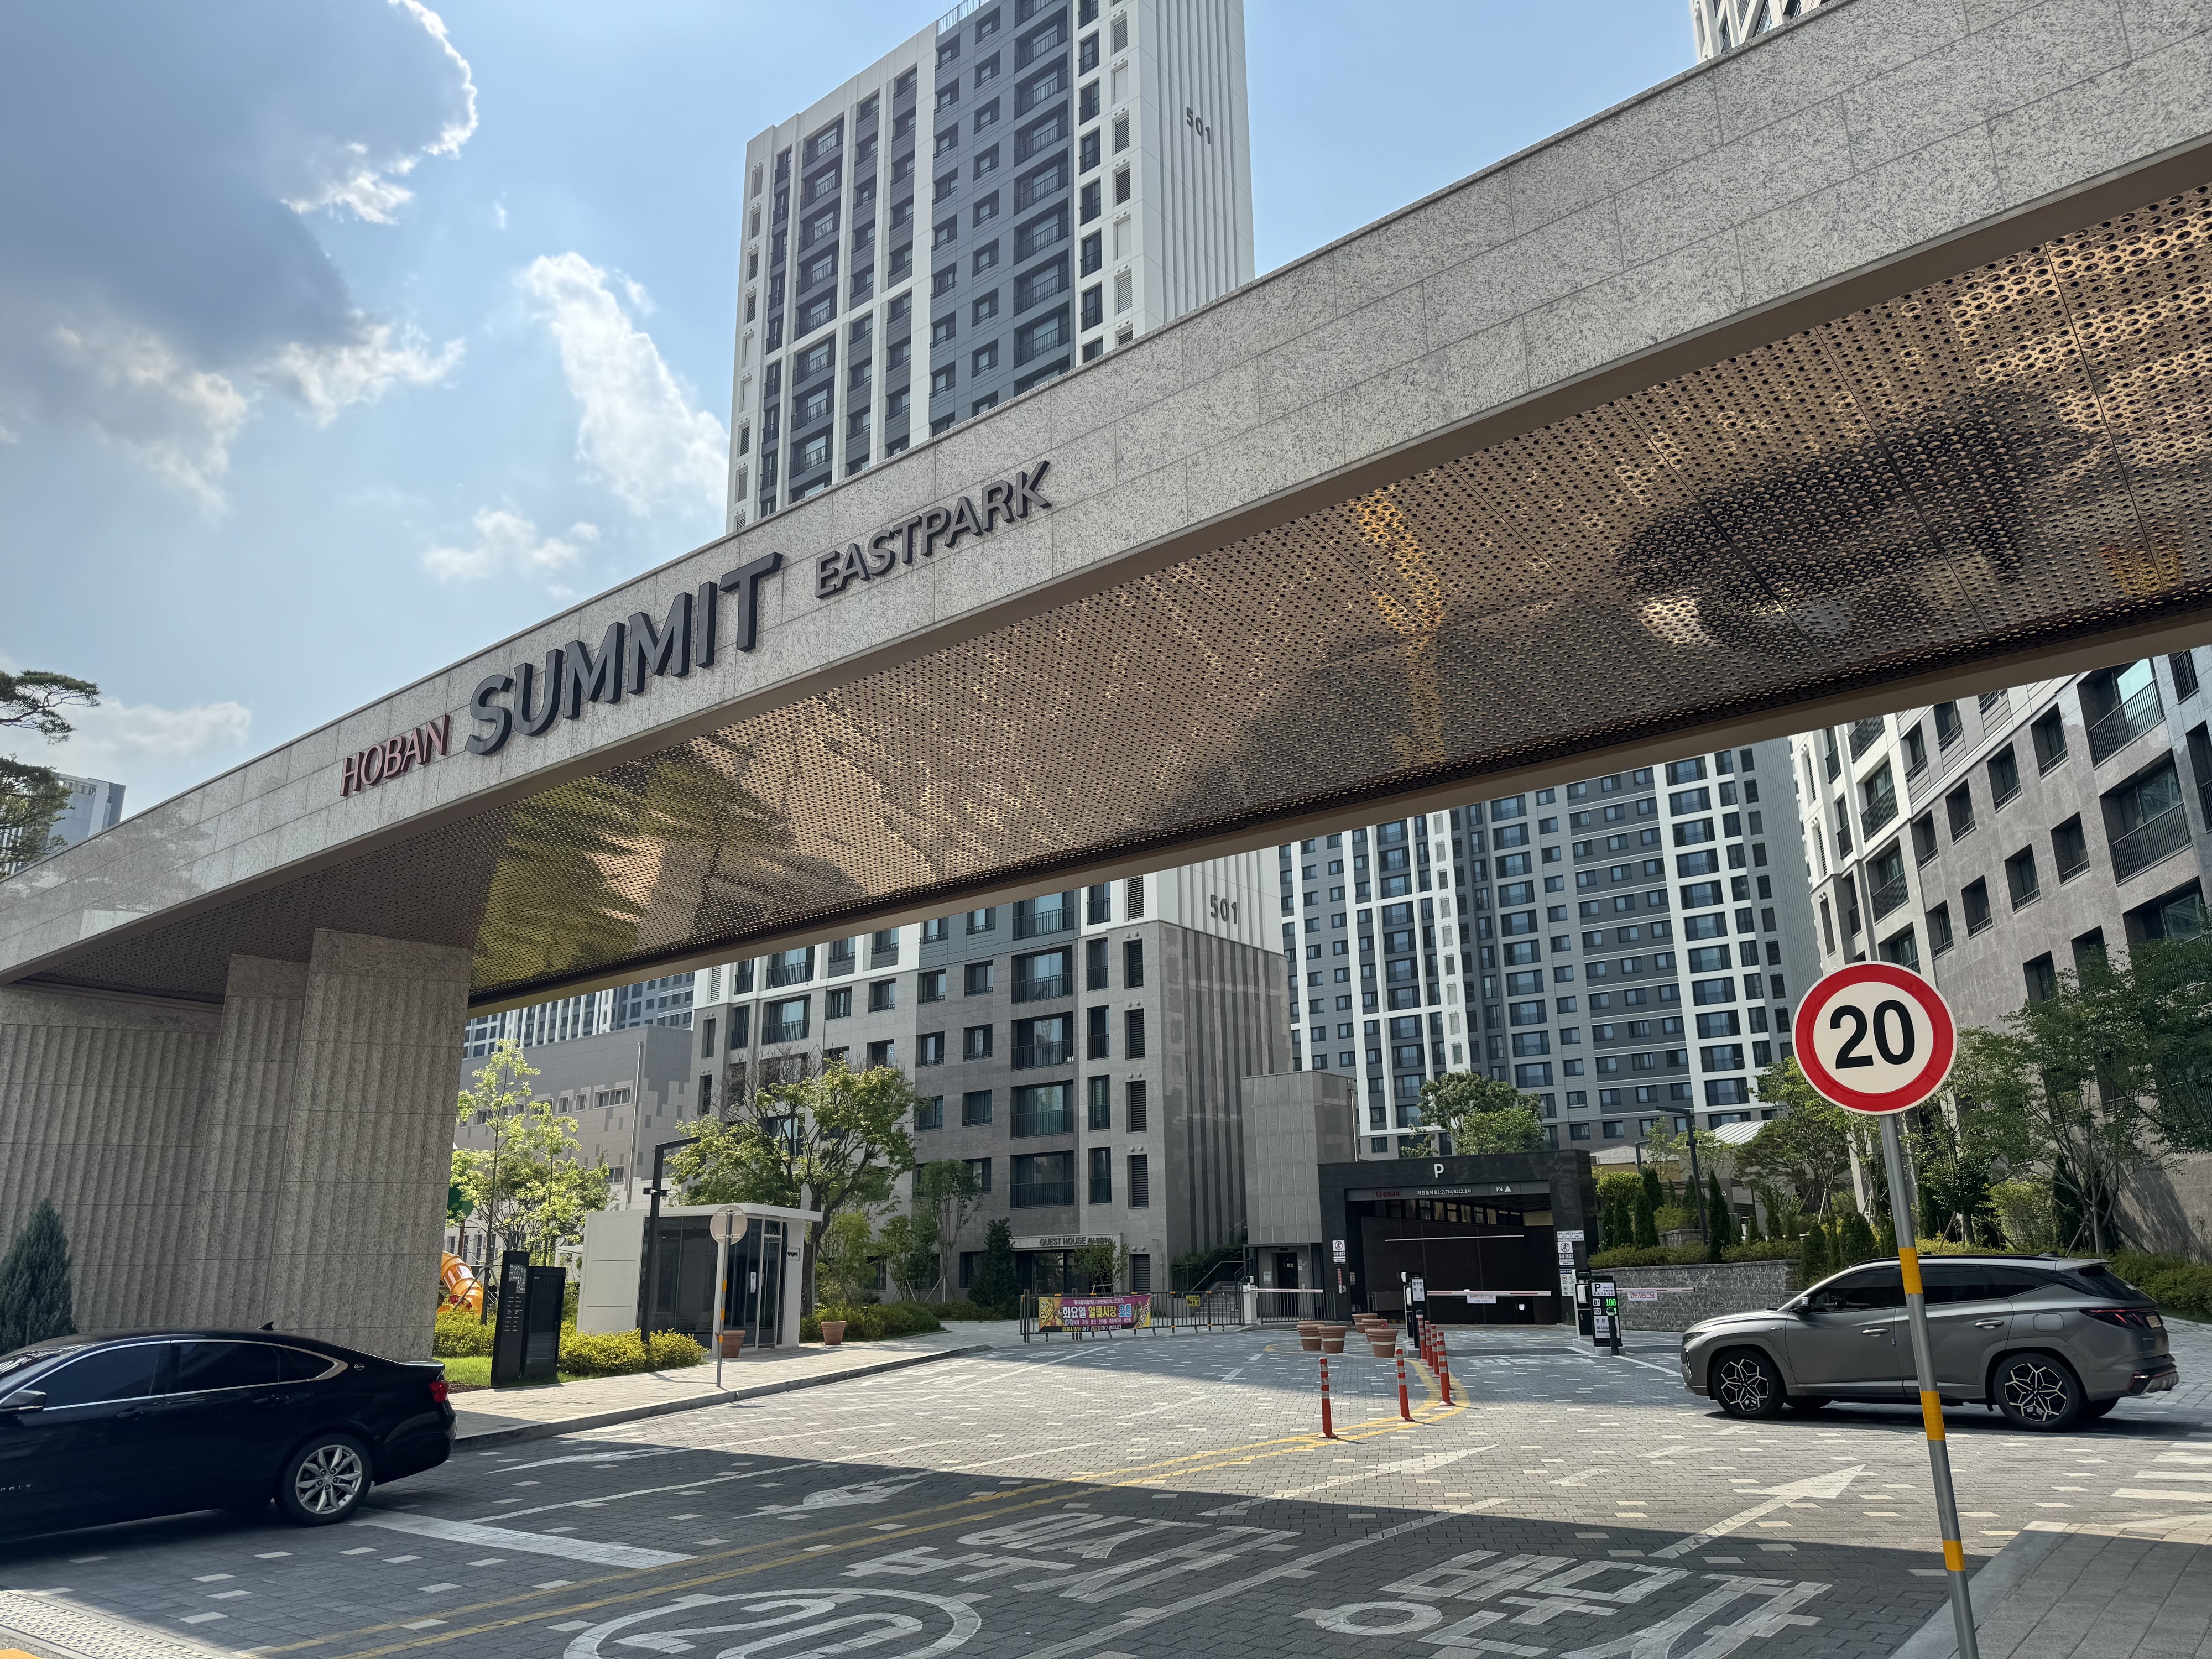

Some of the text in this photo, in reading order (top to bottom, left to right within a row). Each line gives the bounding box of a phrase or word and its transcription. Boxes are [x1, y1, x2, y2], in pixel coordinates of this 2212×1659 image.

[1187, 107, 1211, 144] 501
[340, 460, 1052, 797] HOBAN SUMMIT EASTPARK
[1210, 894, 1237, 924] 501
[1830, 1000, 1915, 1070] 20
[1434, 1163, 1444, 1178] P
[1040, 1238, 1061, 1246] GUEST
[1063, 1237, 1086, 1245] HOUSE
[1594, 1284, 1601, 1292] P
[1040, 1303, 1055, 1323] Sale
[1062, 1304, 1133, 1319] 화요일 알뜰시장 오픈
[837, 1512, 1303, 1603] 입주자
[612, 1598, 924, 1659] 20
